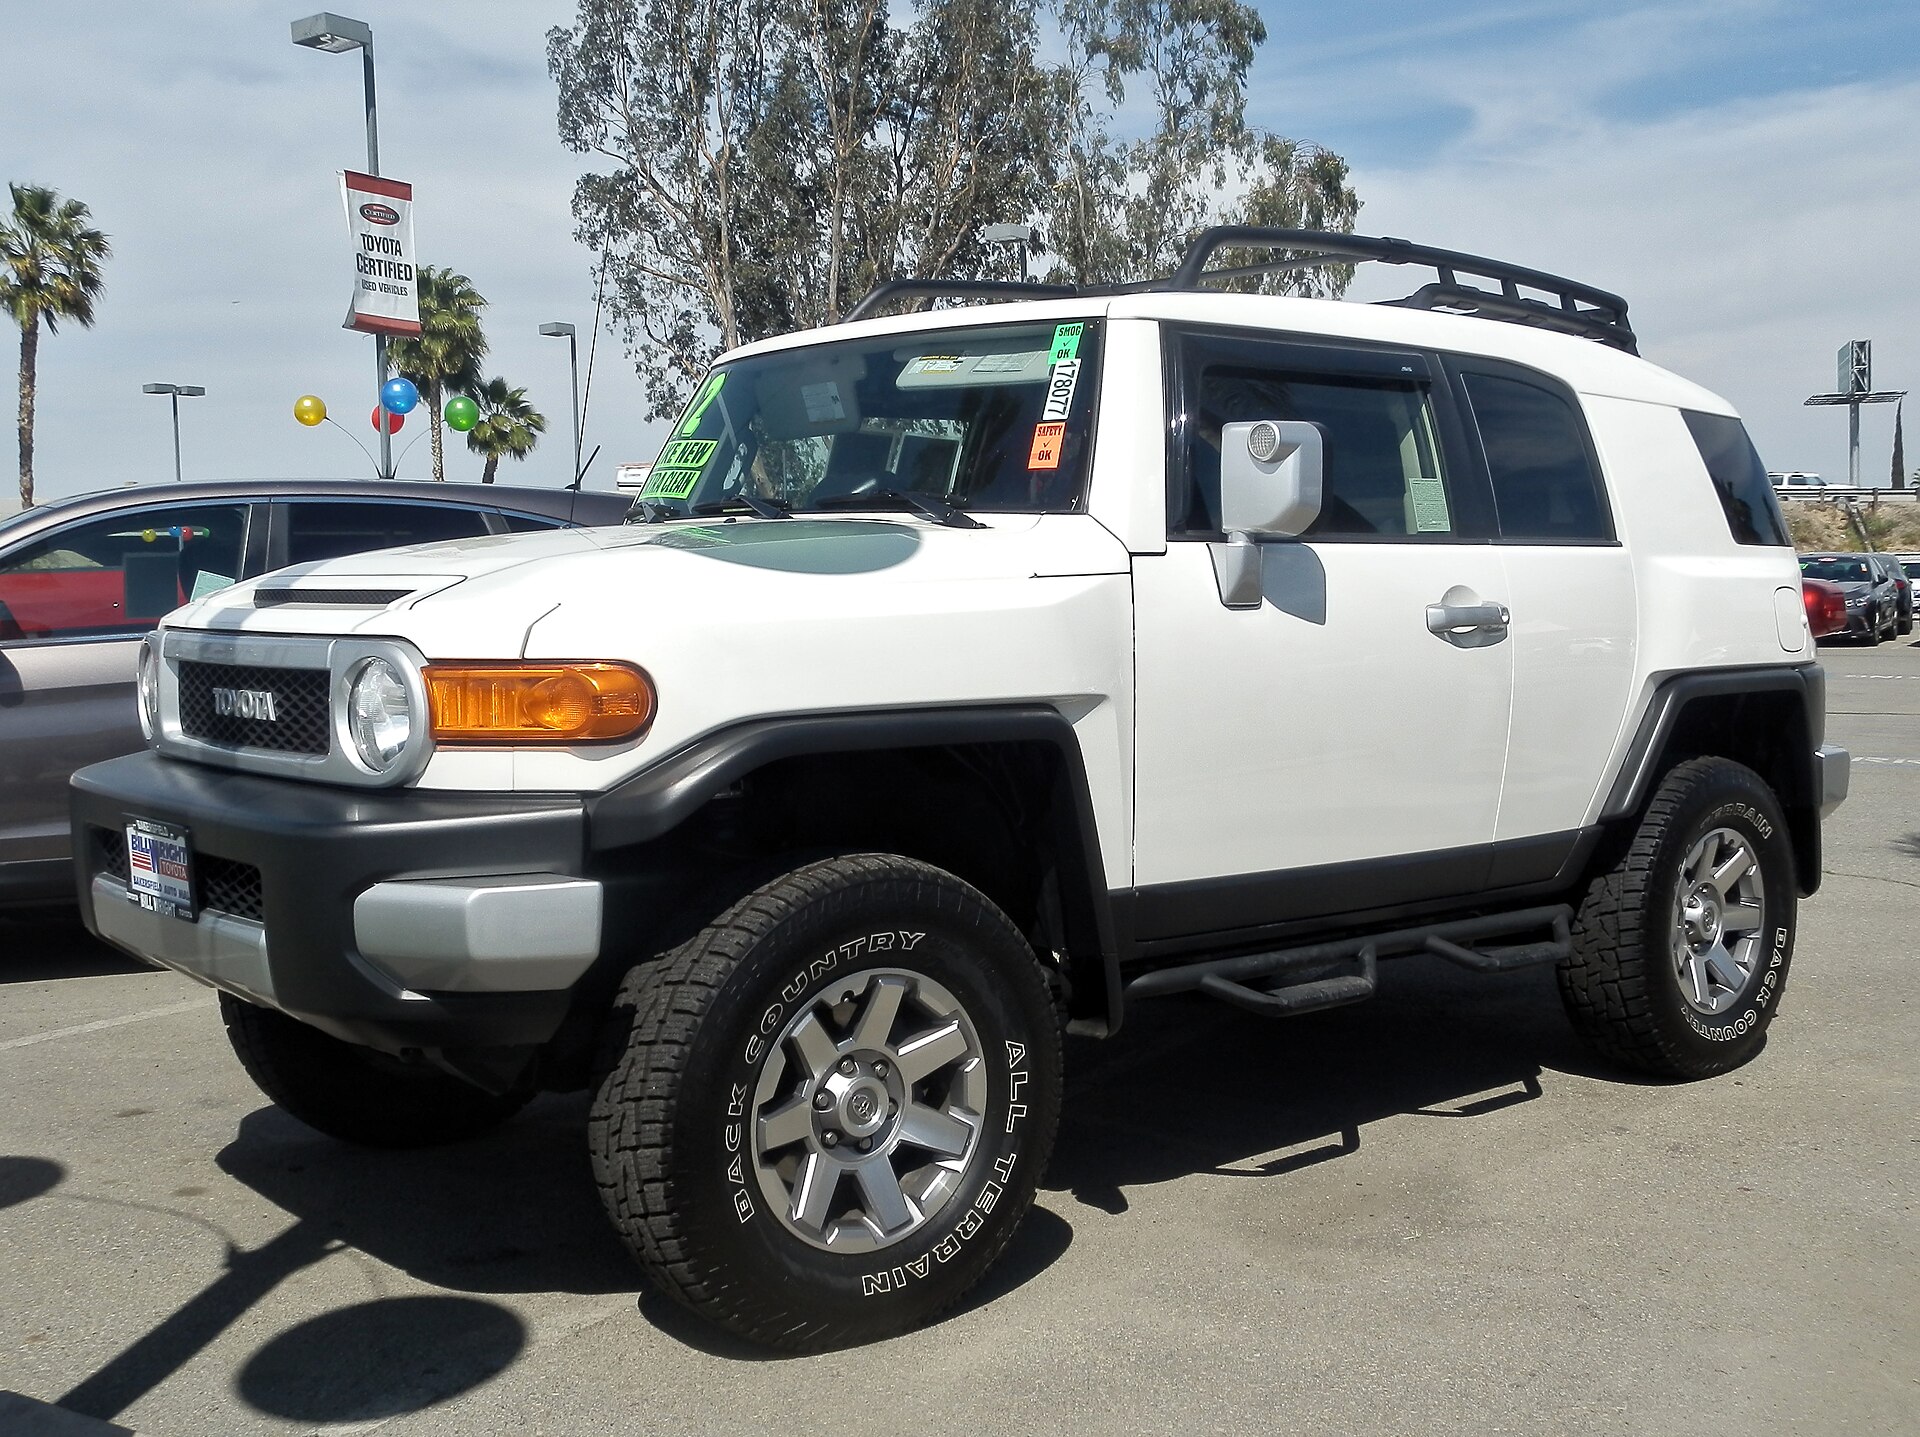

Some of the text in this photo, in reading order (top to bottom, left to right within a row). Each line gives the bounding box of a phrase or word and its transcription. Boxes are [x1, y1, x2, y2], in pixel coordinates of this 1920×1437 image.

[360, 233, 403, 257] TOYOTA
[356, 252, 413, 281] CERTIFIED
[361, 278, 409, 297] USED VEHICLES
[1058, 325, 1081, 337] SMOG
[1056, 348, 1071, 359] OK
[1047, 360, 1077, 416] 178077
[1037, 425, 1063, 437] SAFETY
[674, 441, 714, 464] NEW
[1037, 449, 1053, 461] OK
[660, 470, 697, 494] CLEAN
[212, 686, 277, 722] TOYOTA
[161, 860, 188, 879] TOYOTA
[1680, 927, 1787, 1041] BACK COUNTRY
[725, 930, 925, 1224] BACK COUNTRY
[862, 1040, 1030, 1296] ALL TERRAIN
